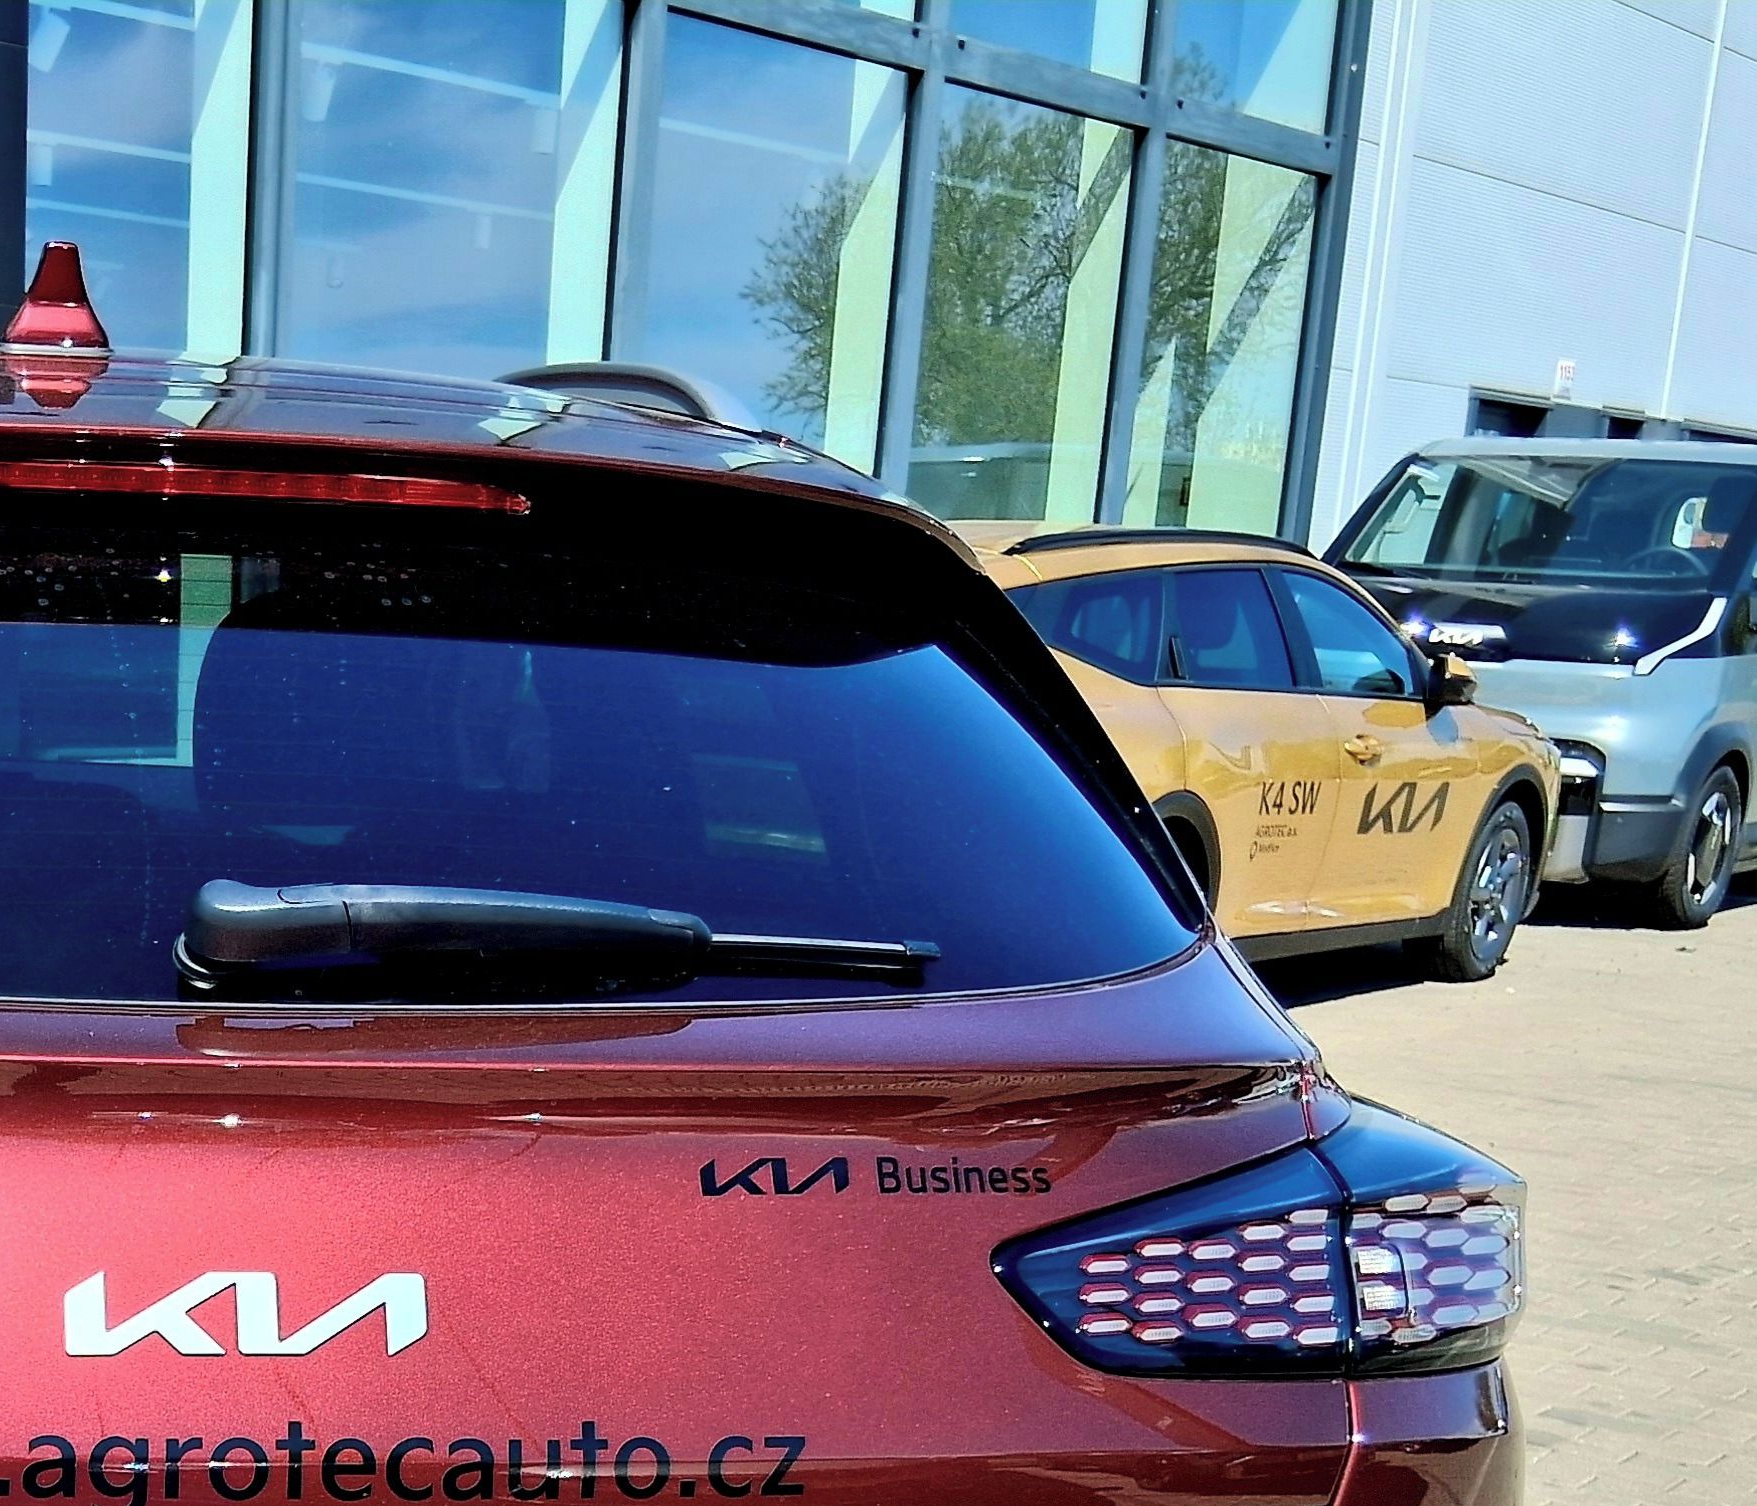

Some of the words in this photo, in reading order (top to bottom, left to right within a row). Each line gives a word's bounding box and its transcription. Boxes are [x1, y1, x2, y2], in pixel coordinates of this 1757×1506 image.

[1259, 781, 1285, 816] K4
[1288, 780, 1322, 815] SW
[1357, 782, 1450, 835] KIA
[699, 1157, 849, 1196] KIA
[877, 1157, 1053, 1195] Business
[64, 1271, 428, 1357] KIA
